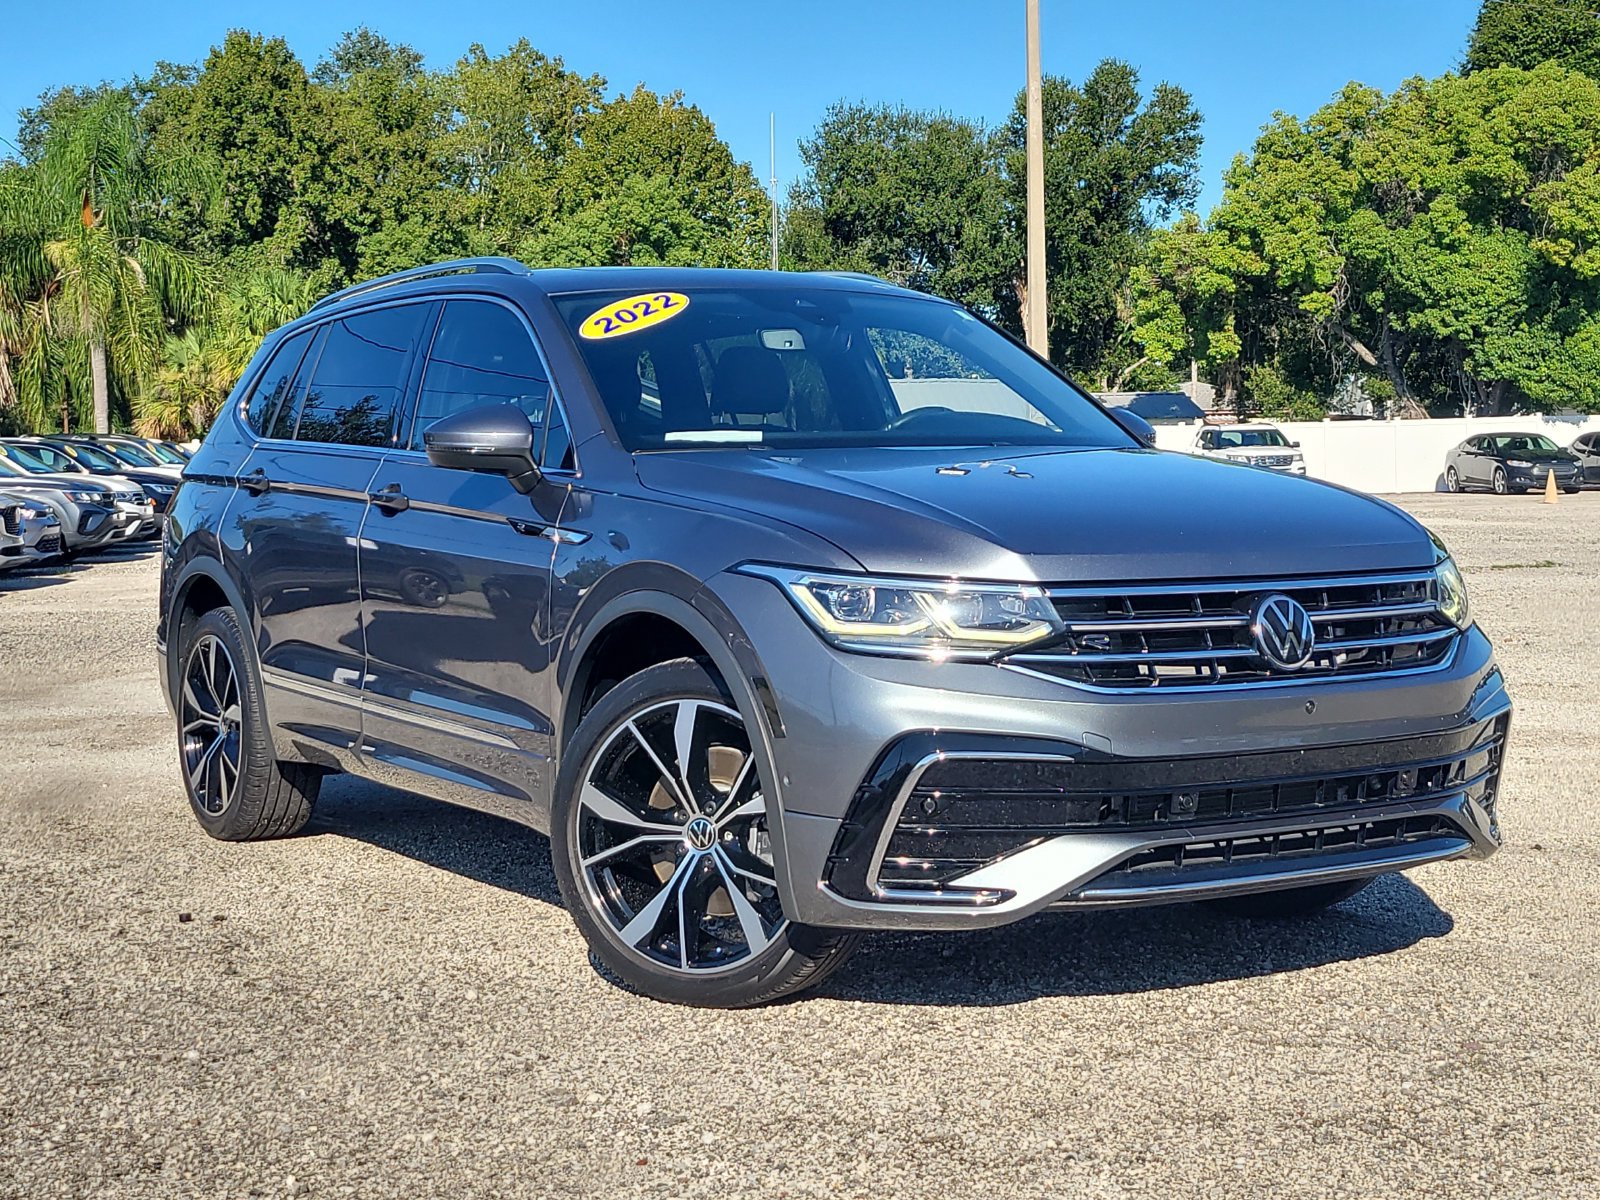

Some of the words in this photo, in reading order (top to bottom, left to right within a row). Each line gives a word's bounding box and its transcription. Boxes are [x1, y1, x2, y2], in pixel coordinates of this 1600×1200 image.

[594, 294, 680, 334] 2022
[1258, 595, 1313, 668] VW
[689, 820, 715, 850] VW
